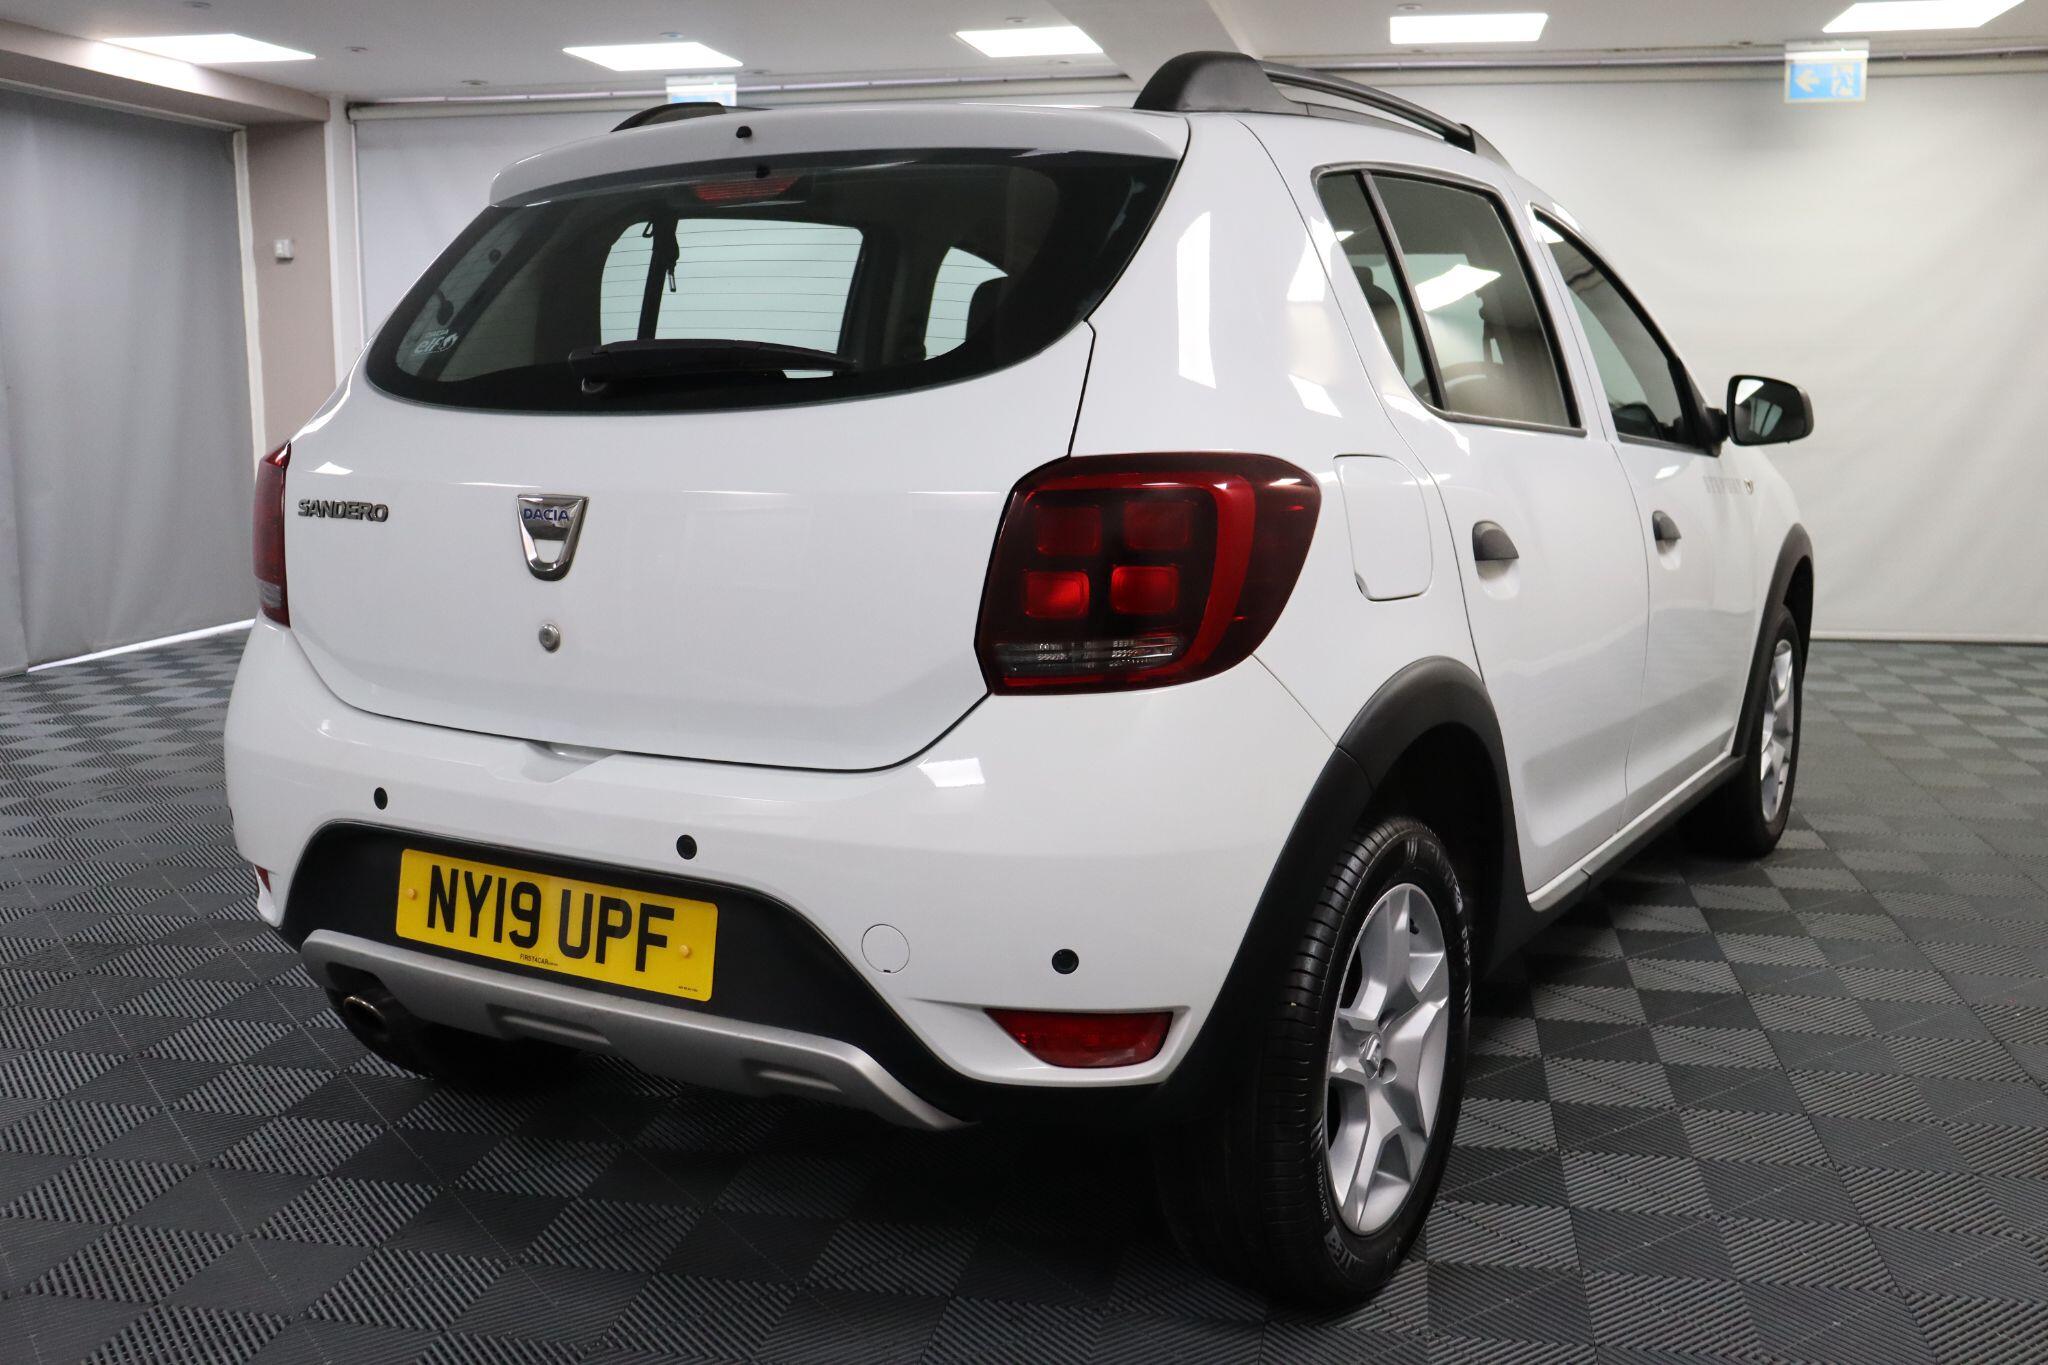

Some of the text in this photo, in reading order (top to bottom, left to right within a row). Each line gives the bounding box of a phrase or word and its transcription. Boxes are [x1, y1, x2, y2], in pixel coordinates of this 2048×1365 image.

[298, 499, 389, 522] SANDERO
[523, 508, 570, 521] DACIA
[427, 864, 675, 973] NY19 UPF
